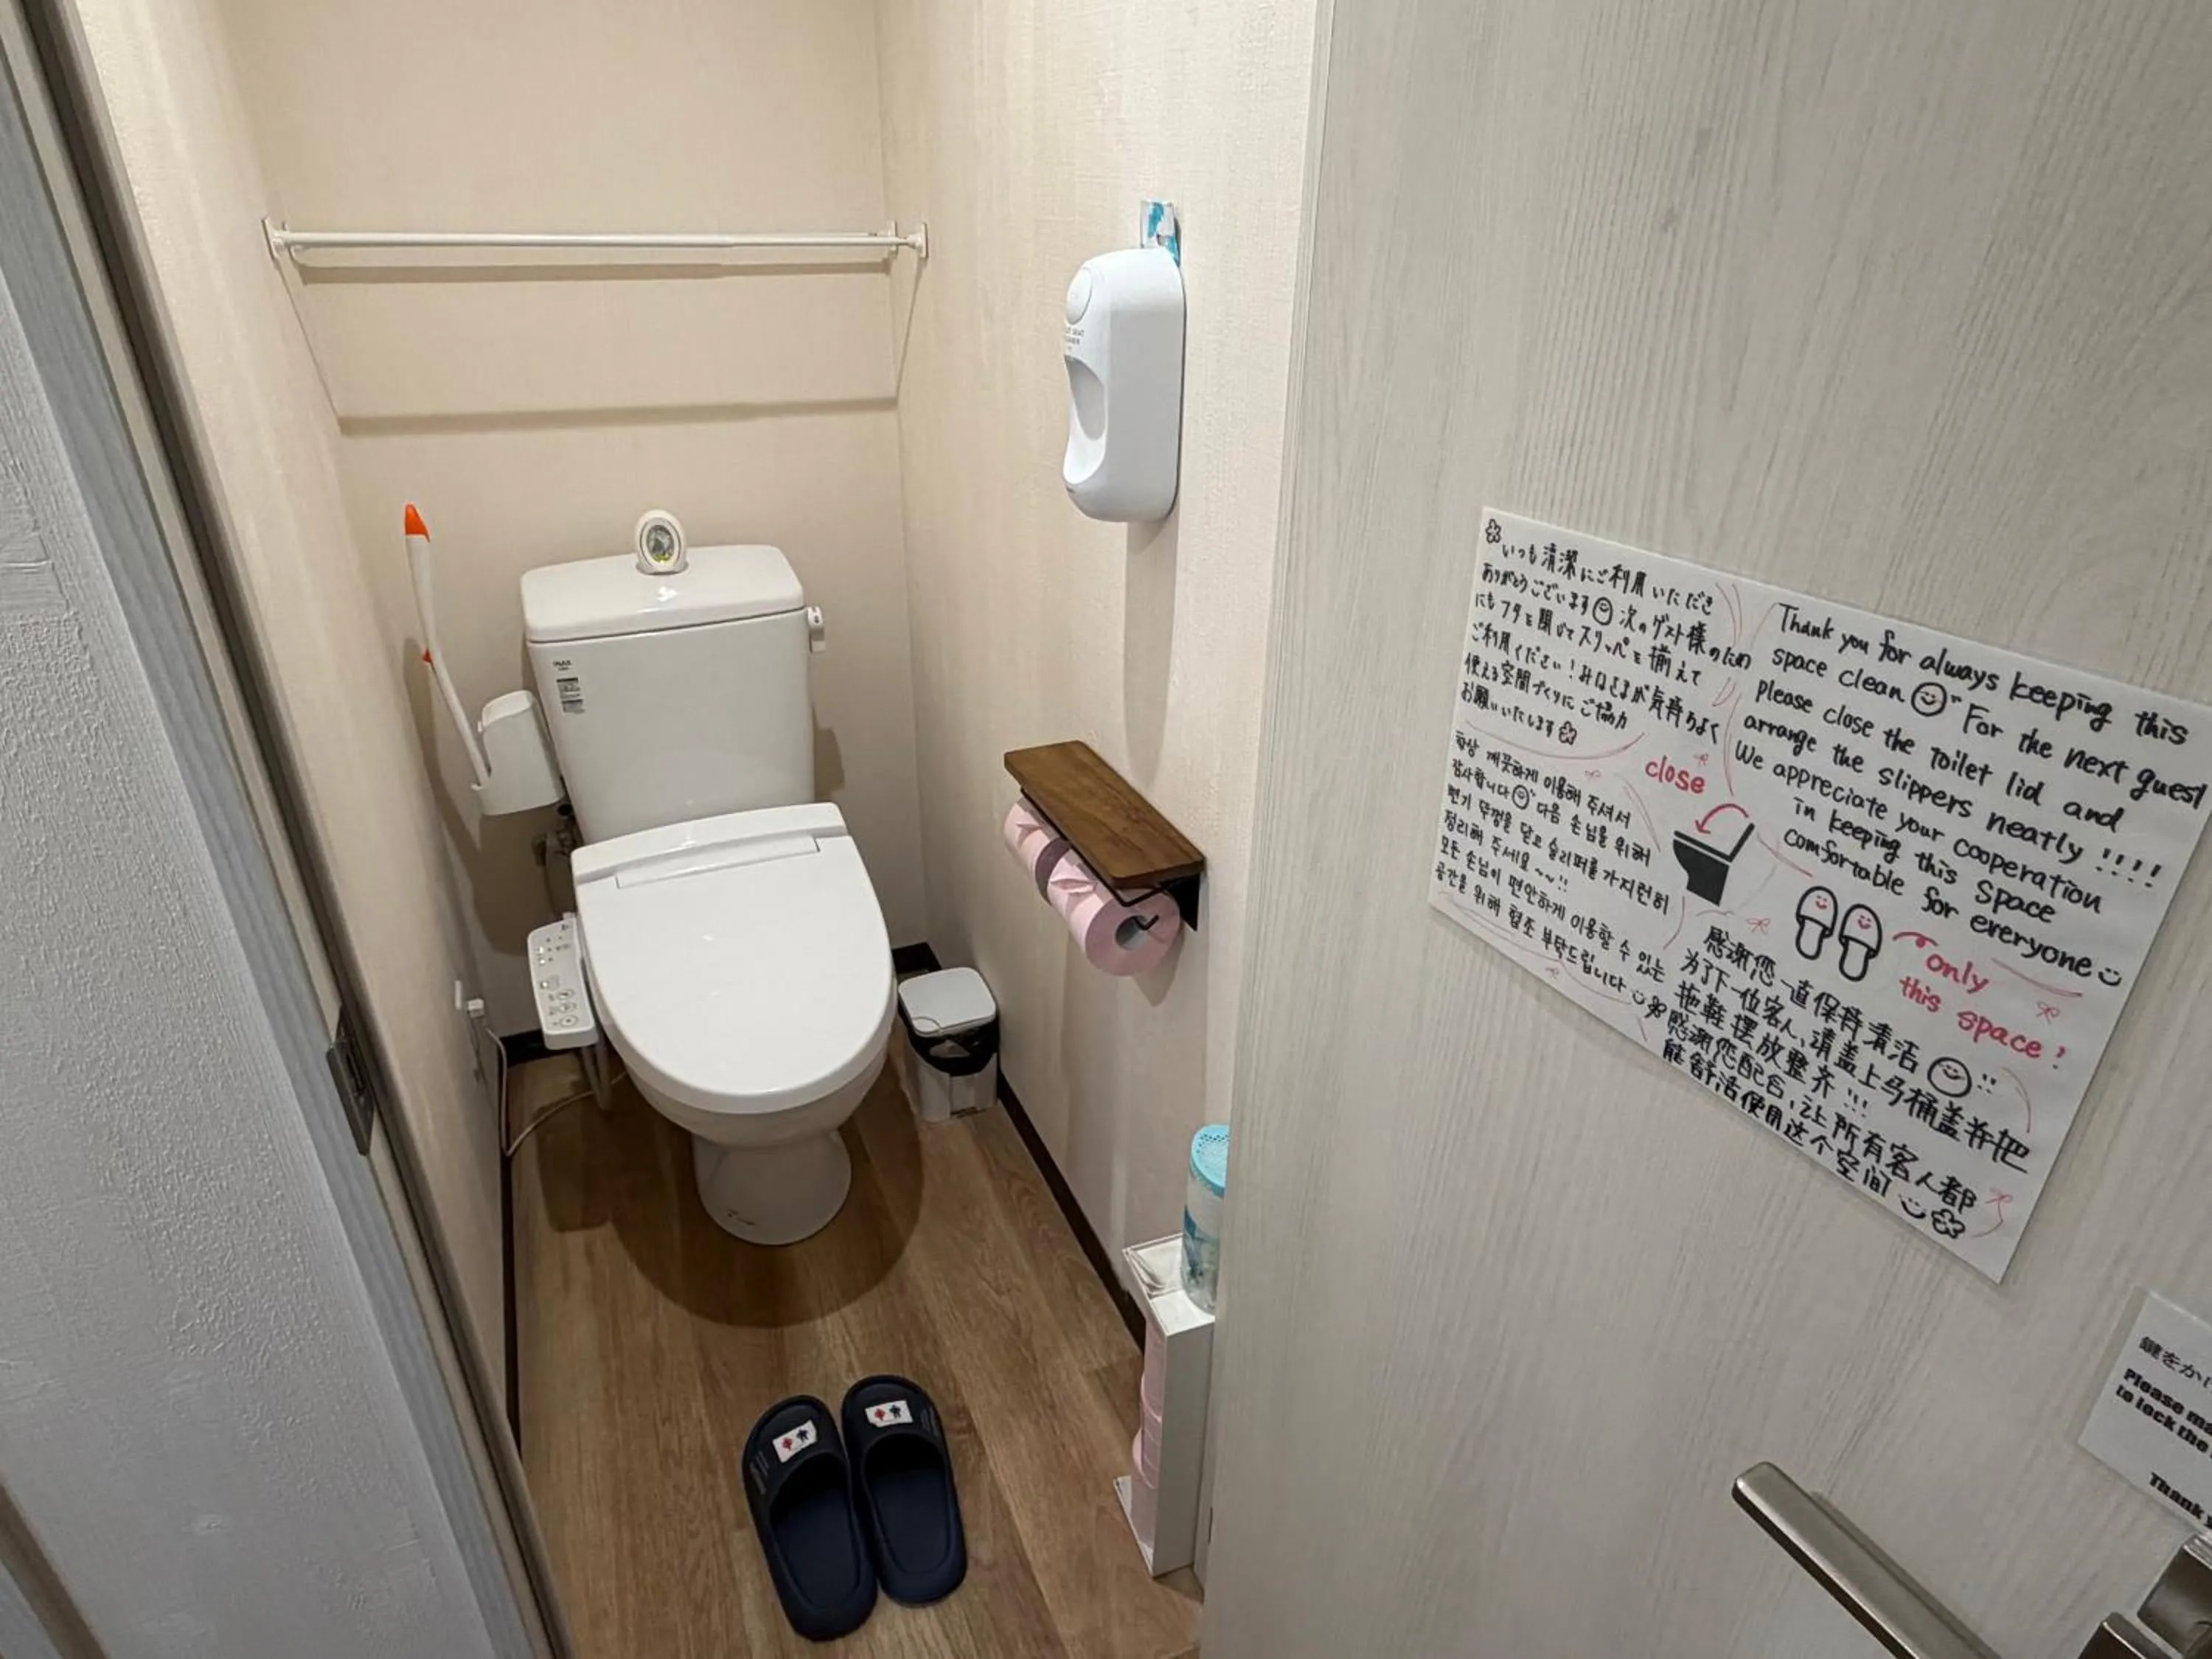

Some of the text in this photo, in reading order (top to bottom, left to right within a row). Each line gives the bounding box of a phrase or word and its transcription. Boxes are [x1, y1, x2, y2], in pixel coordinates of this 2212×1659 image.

[1778, 602, 2189, 745] Thank you for always keeping this
[1644, 755, 1705, 794] close
[1755, 679, 1814, 714] Please
[1823, 705, 1875, 738] close
[1882, 727, 1916, 755] the
[2006, 771, 2045, 806] lid
[2063, 801, 2125, 833] and
[1772, 648, 2208, 810] space clean For the next guest
[1451, 758, 1651, 868] 감사합니다 다음 손님을 위해
[1455, 731, 1480, 757] 항상
[1544, 776, 1582, 807] 이용해
[1587, 793, 1631, 829] 주셔서
[1735, 740, 1764, 770] We
[1773, 763, 1888, 820] appreciate
[1895, 812, 1945, 841] your
[1743, 714, 1818, 757] arrange
[1832, 743, 1865, 773] the
[1879, 767, 1973, 818] slippers
[1986, 811, 2084, 865] neatly
[1444, 810, 1484, 846] 정리해
[1491, 835, 1530, 872] 주세요
[1448, 783, 1669, 915] 변기 뚜껑을 닫고 슬리퍼를 가지런히
[1793, 797, 1816, 821] in
[1829, 809, 1902, 864] keeping
[1914, 851, 1958, 885] this
[1435, 860, 1627, 993] 공간을 위해 협조 부탁드립니다
[1440, 835, 1666, 983] 모든 손님이 편안하게 이용할 수 있는
[1921, 886, 1959, 919] for
[1969, 914, 2092, 978] everyone
[1899, 975, 1942, 1013] this
[1925, 953, 1990, 994] only
[2115, 1384, 2209, 1454] to lock the
[2124, 1368, 2185, 1415] Please
[2149, 1471, 2205, 1520] Thank
